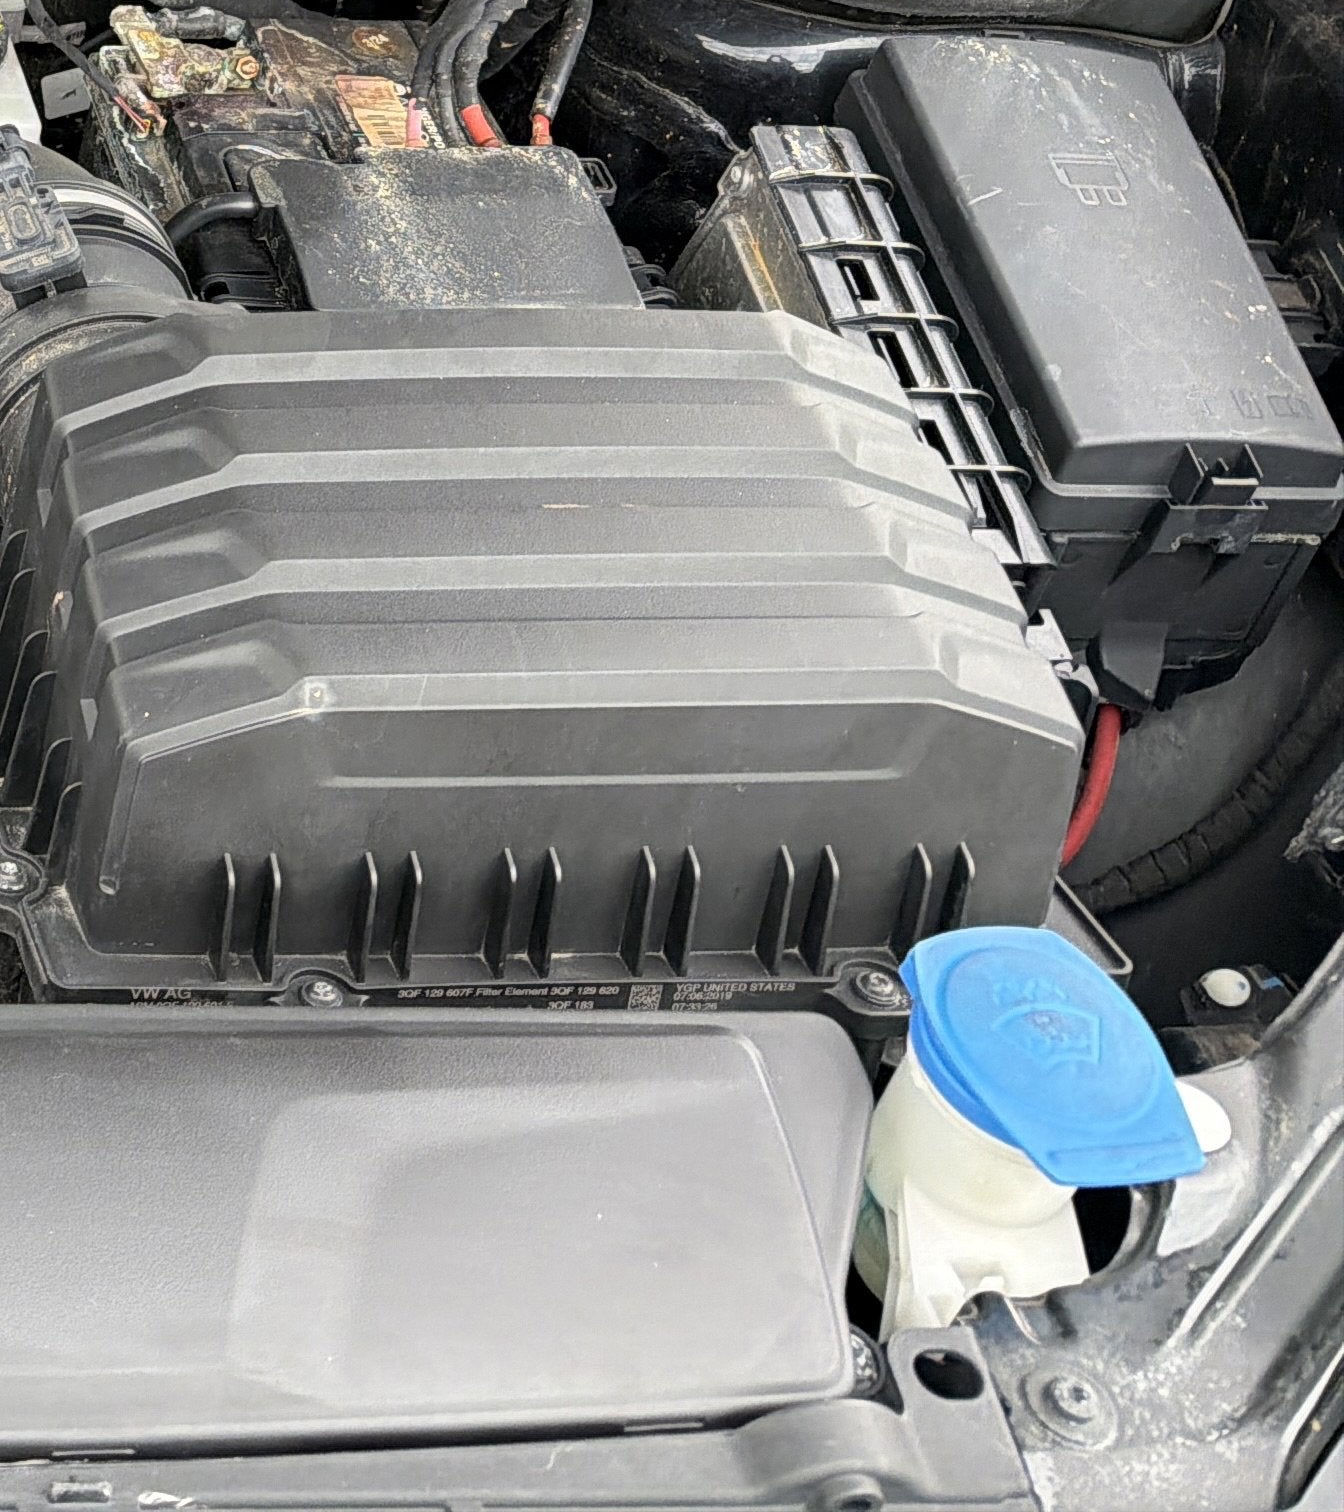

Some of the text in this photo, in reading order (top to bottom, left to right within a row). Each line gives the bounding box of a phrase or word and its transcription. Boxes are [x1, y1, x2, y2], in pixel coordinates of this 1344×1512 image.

[504, 987, 549, 996] Element
[703, 983, 747, 992] UNITED
[749, 982, 796, 992] STATES
[131, 988, 192, 1000] VW AG
